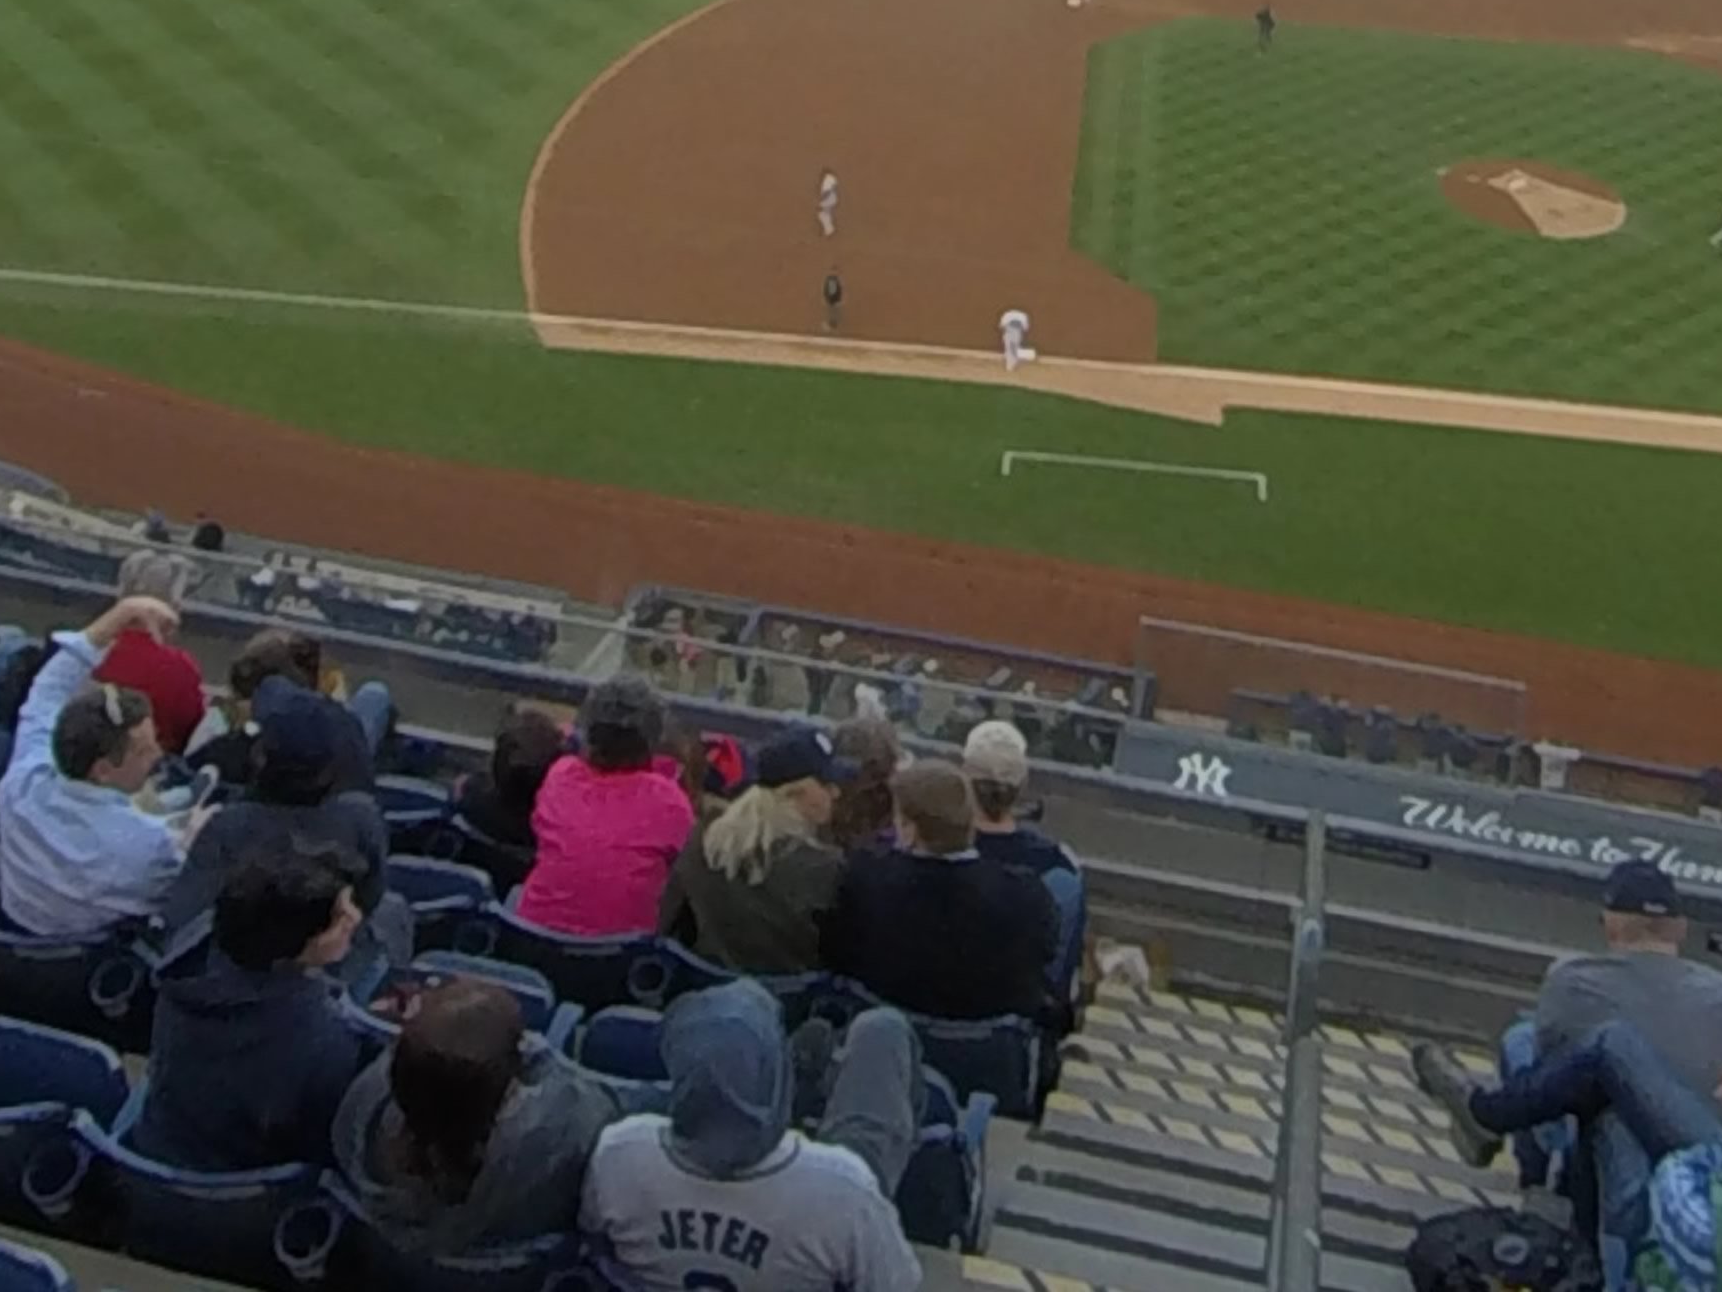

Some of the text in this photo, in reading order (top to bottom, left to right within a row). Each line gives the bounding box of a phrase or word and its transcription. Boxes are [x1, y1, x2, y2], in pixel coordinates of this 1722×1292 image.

[1399, 794, 1581, 858] Welcome
[1588, 830, 1629, 864] to
[656, 1208, 771, 1272] JETER
